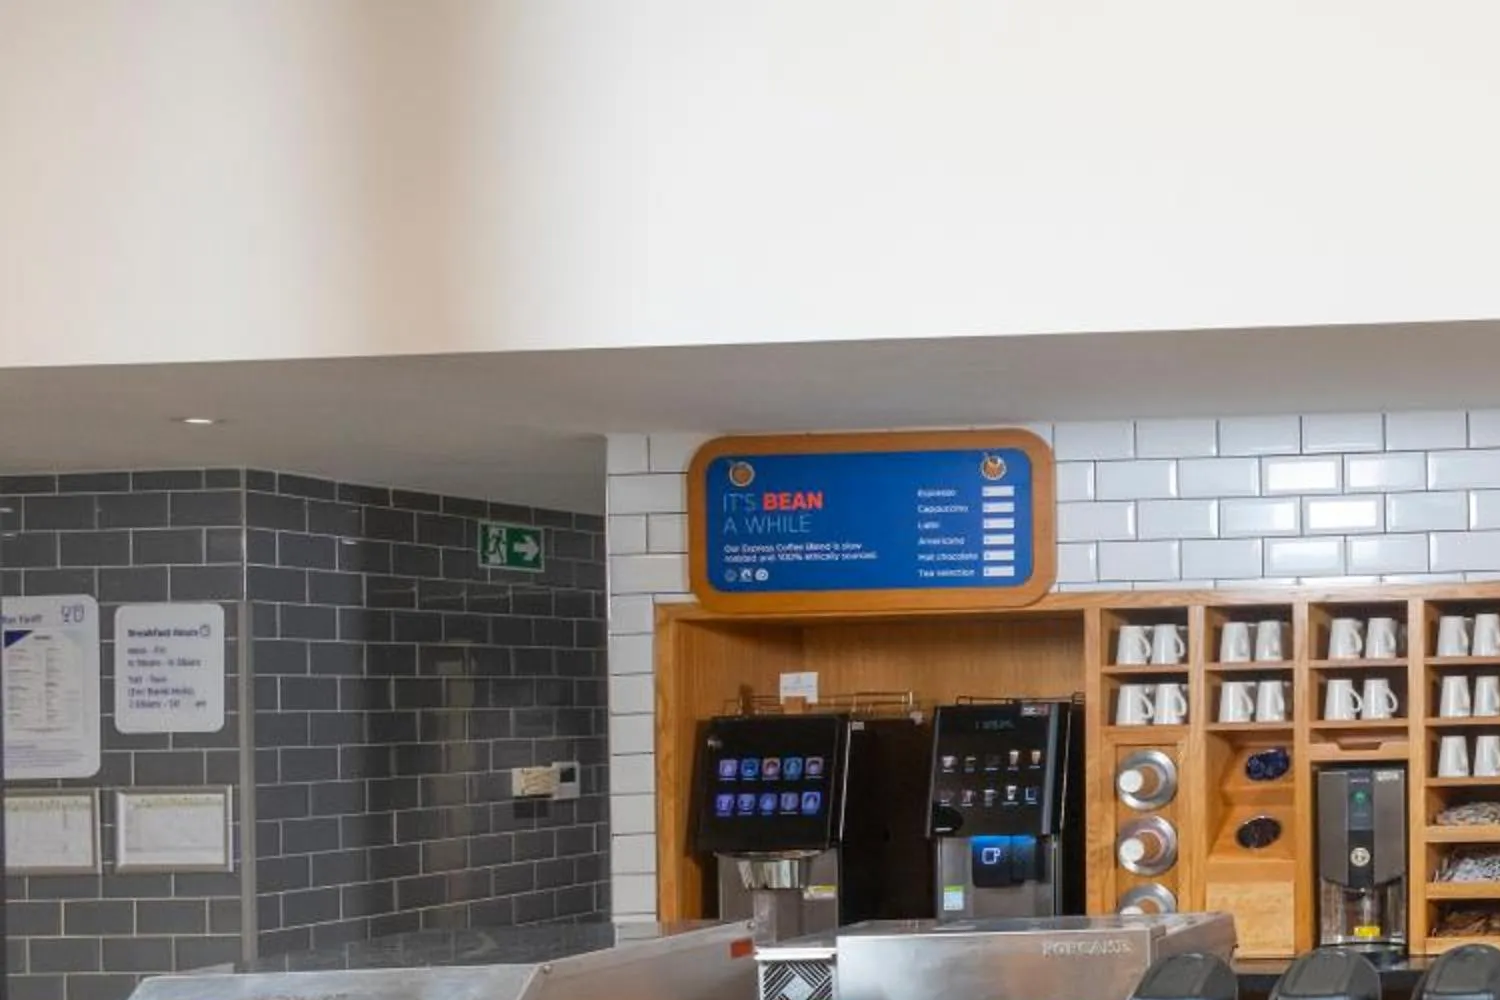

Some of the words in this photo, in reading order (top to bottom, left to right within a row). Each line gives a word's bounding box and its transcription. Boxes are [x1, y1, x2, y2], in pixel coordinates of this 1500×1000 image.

[723, 492, 756, 513] IT'S
[762, 490, 824, 511] BEAN
[723, 516, 738, 535] A
[744, 513, 812, 535] WHILE
